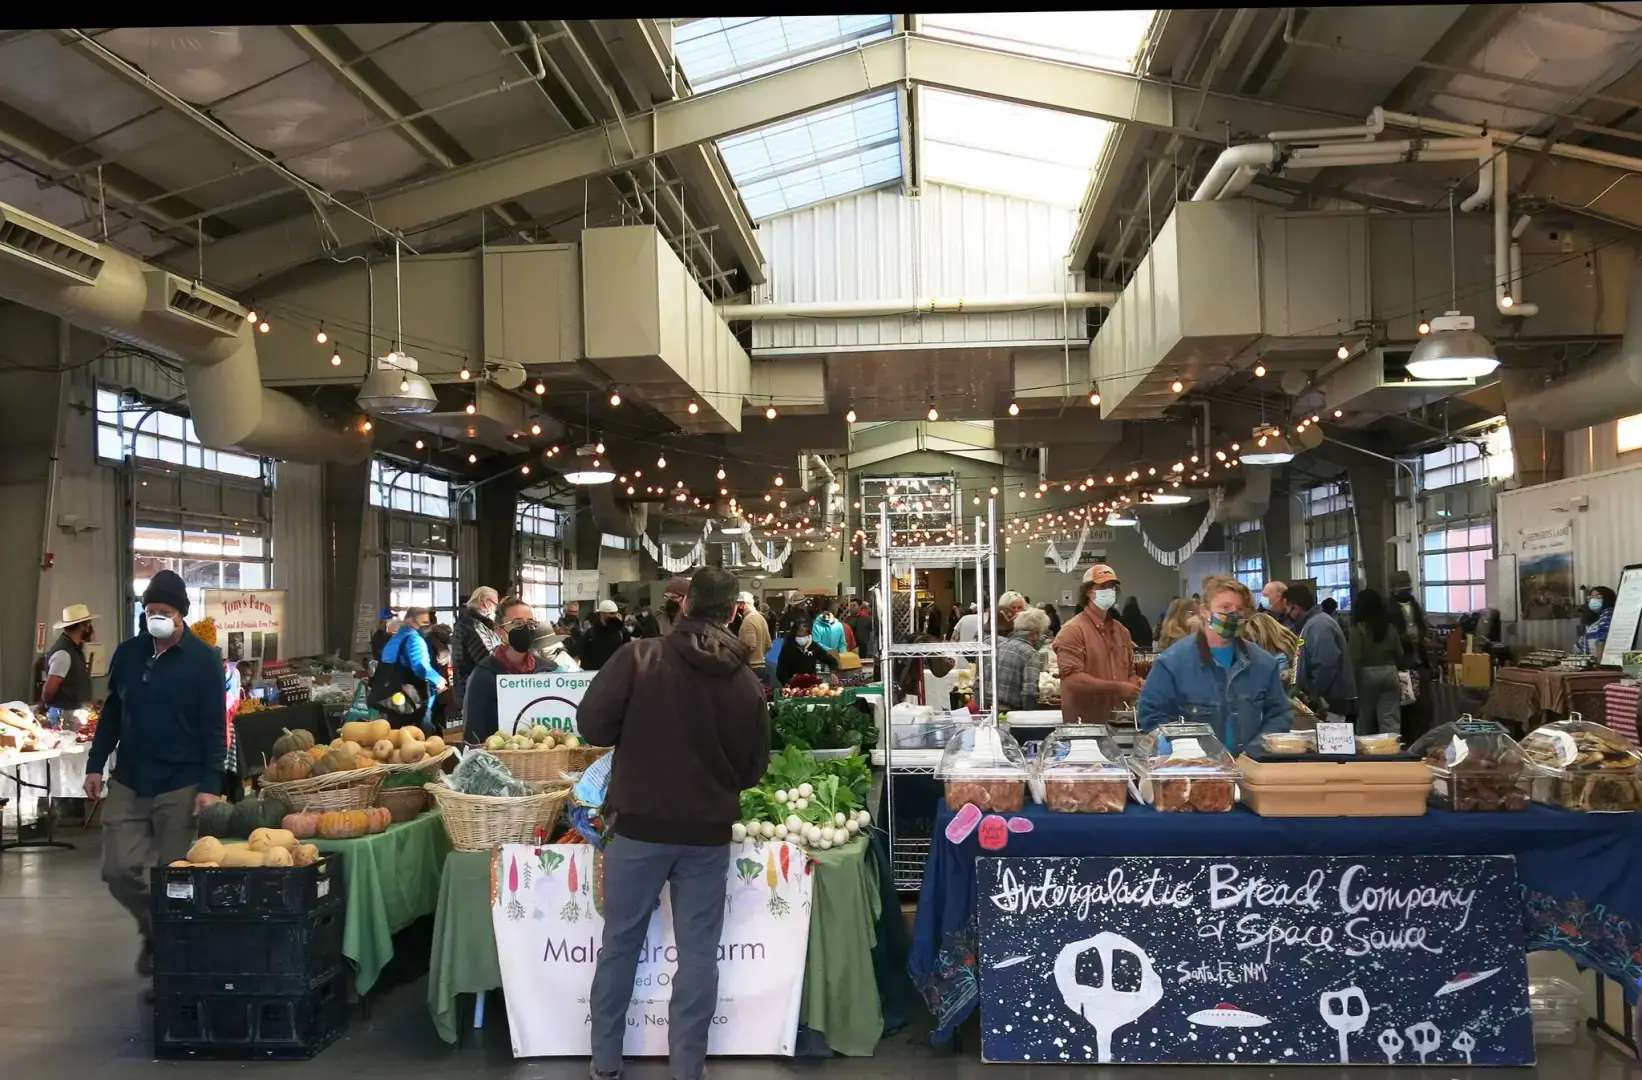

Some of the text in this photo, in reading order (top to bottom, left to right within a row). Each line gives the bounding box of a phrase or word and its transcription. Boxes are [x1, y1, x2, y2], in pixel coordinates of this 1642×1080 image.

[222, 594, 272, 615] Tony's Farm
[500, 677, 593, 689] Certified Organ
[531, 716, 573, 733] USDA
[990, 863, 1478, 931] Intergalactic Bread Company
[543, 937, 766, 964] Maldro arm
[1236, 913, 1335, 965] Space
[1345, 917, 1444, 956] Sauce
[1176, 959, 1217, 984] Santa
